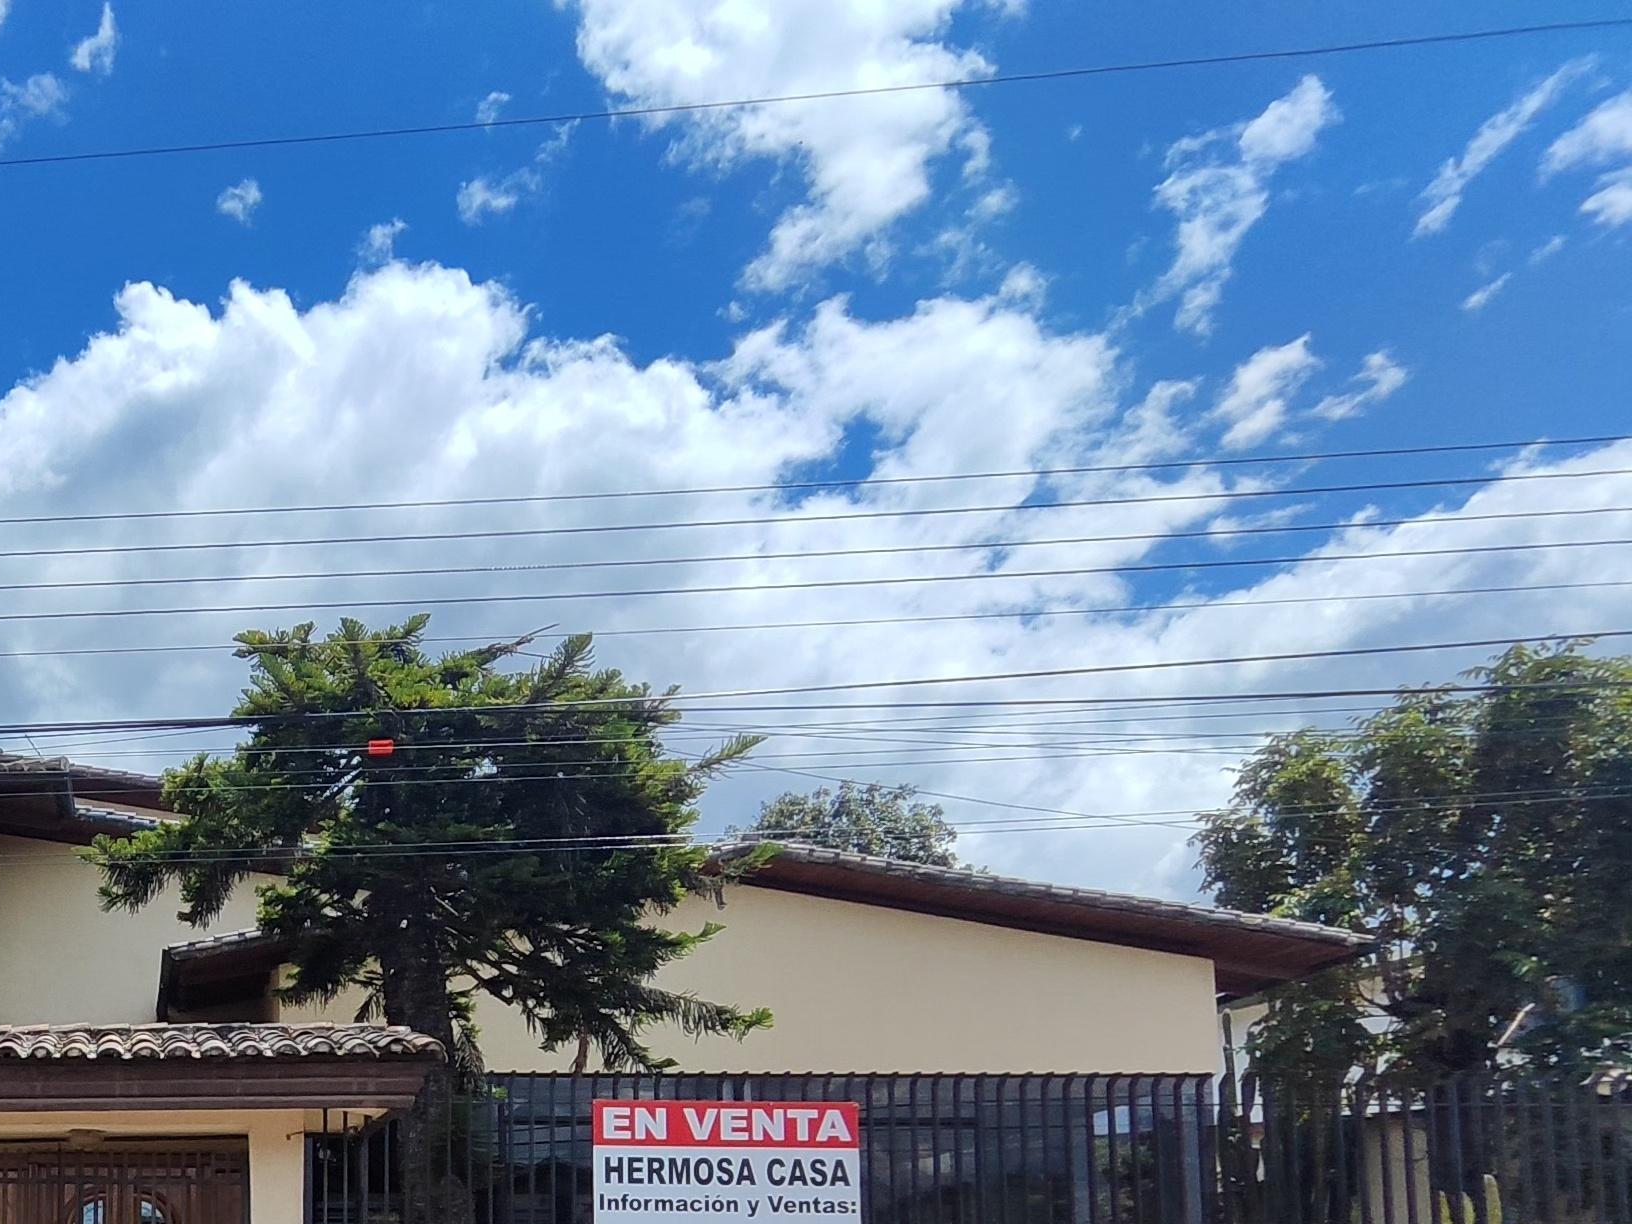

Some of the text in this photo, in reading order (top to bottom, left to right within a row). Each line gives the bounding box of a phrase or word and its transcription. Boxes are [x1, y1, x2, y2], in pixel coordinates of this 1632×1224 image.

[602, 1107, 851, 1141] EN VENTA
[604, 1156, 850, 1186] HERMOSA CASA
[599, 1194, 857, 1217] Información y Ventas:
